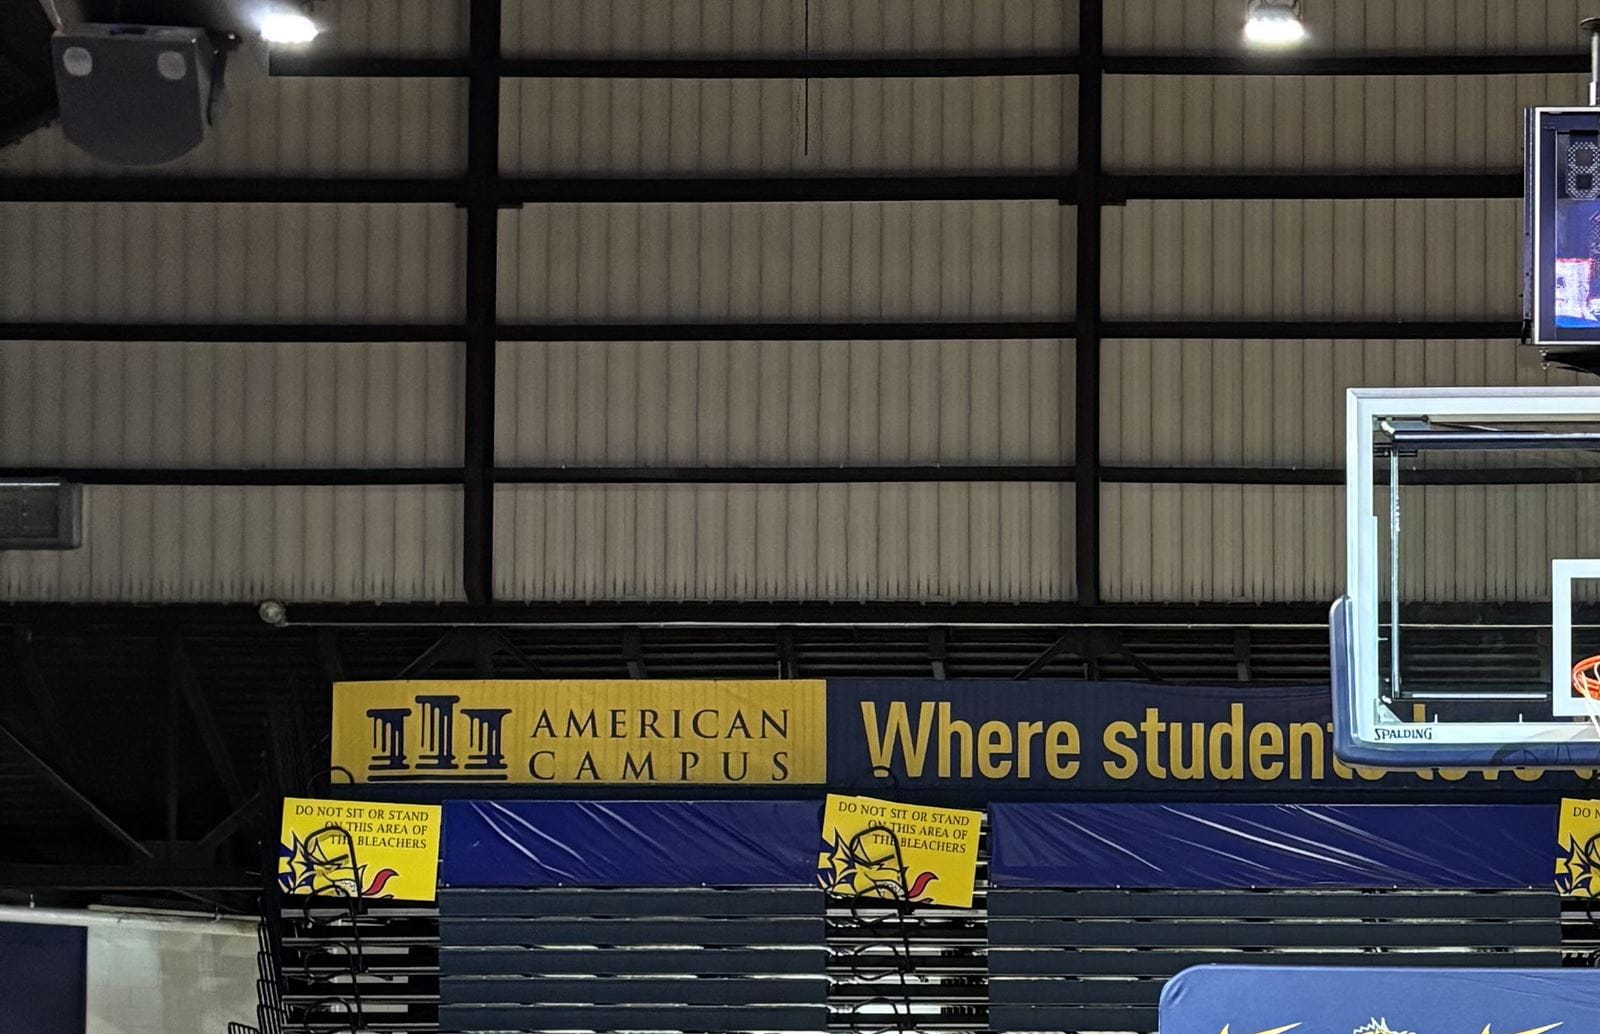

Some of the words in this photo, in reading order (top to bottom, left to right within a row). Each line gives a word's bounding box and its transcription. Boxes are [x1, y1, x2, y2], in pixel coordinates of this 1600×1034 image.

[530, 708, 790, 740] AMERICAN
[861, 700, 1081, 780] Where
[1102, 702, 1389, 781] studen
[1374, 727, 1433, 741] SPALDING
[528, 750, 790, 782] CAMPUS
[295, 805, 314, 815] DO
[317, 806, 343, 817] NOT
[346, 808, 365, 819] SIT
[368, 809, 385, 820] OR
[388, 810, 429, 822] STAND
[838, 801, 857, 813] DO
[860, 804, 886, 817] NOT
[890, 808, 908, 820] SIT
[911, 810, 928, 822] OR
[931, 812, 970, 826] STAND
[1573, 806, 1591, 818] DO
[346, 821, 373, 833] THIS
[377, 823, 408, 834] AREA
[412, 825, 428, 836] OF
[889, 821, 916, 835] THIS
[919, 824, 949, 837] AREA
[952, 828, 969, 840] OF
[357, 835, 427, 849] BLEACHERS
[901, 836, 966, 854] BLEACHERS
